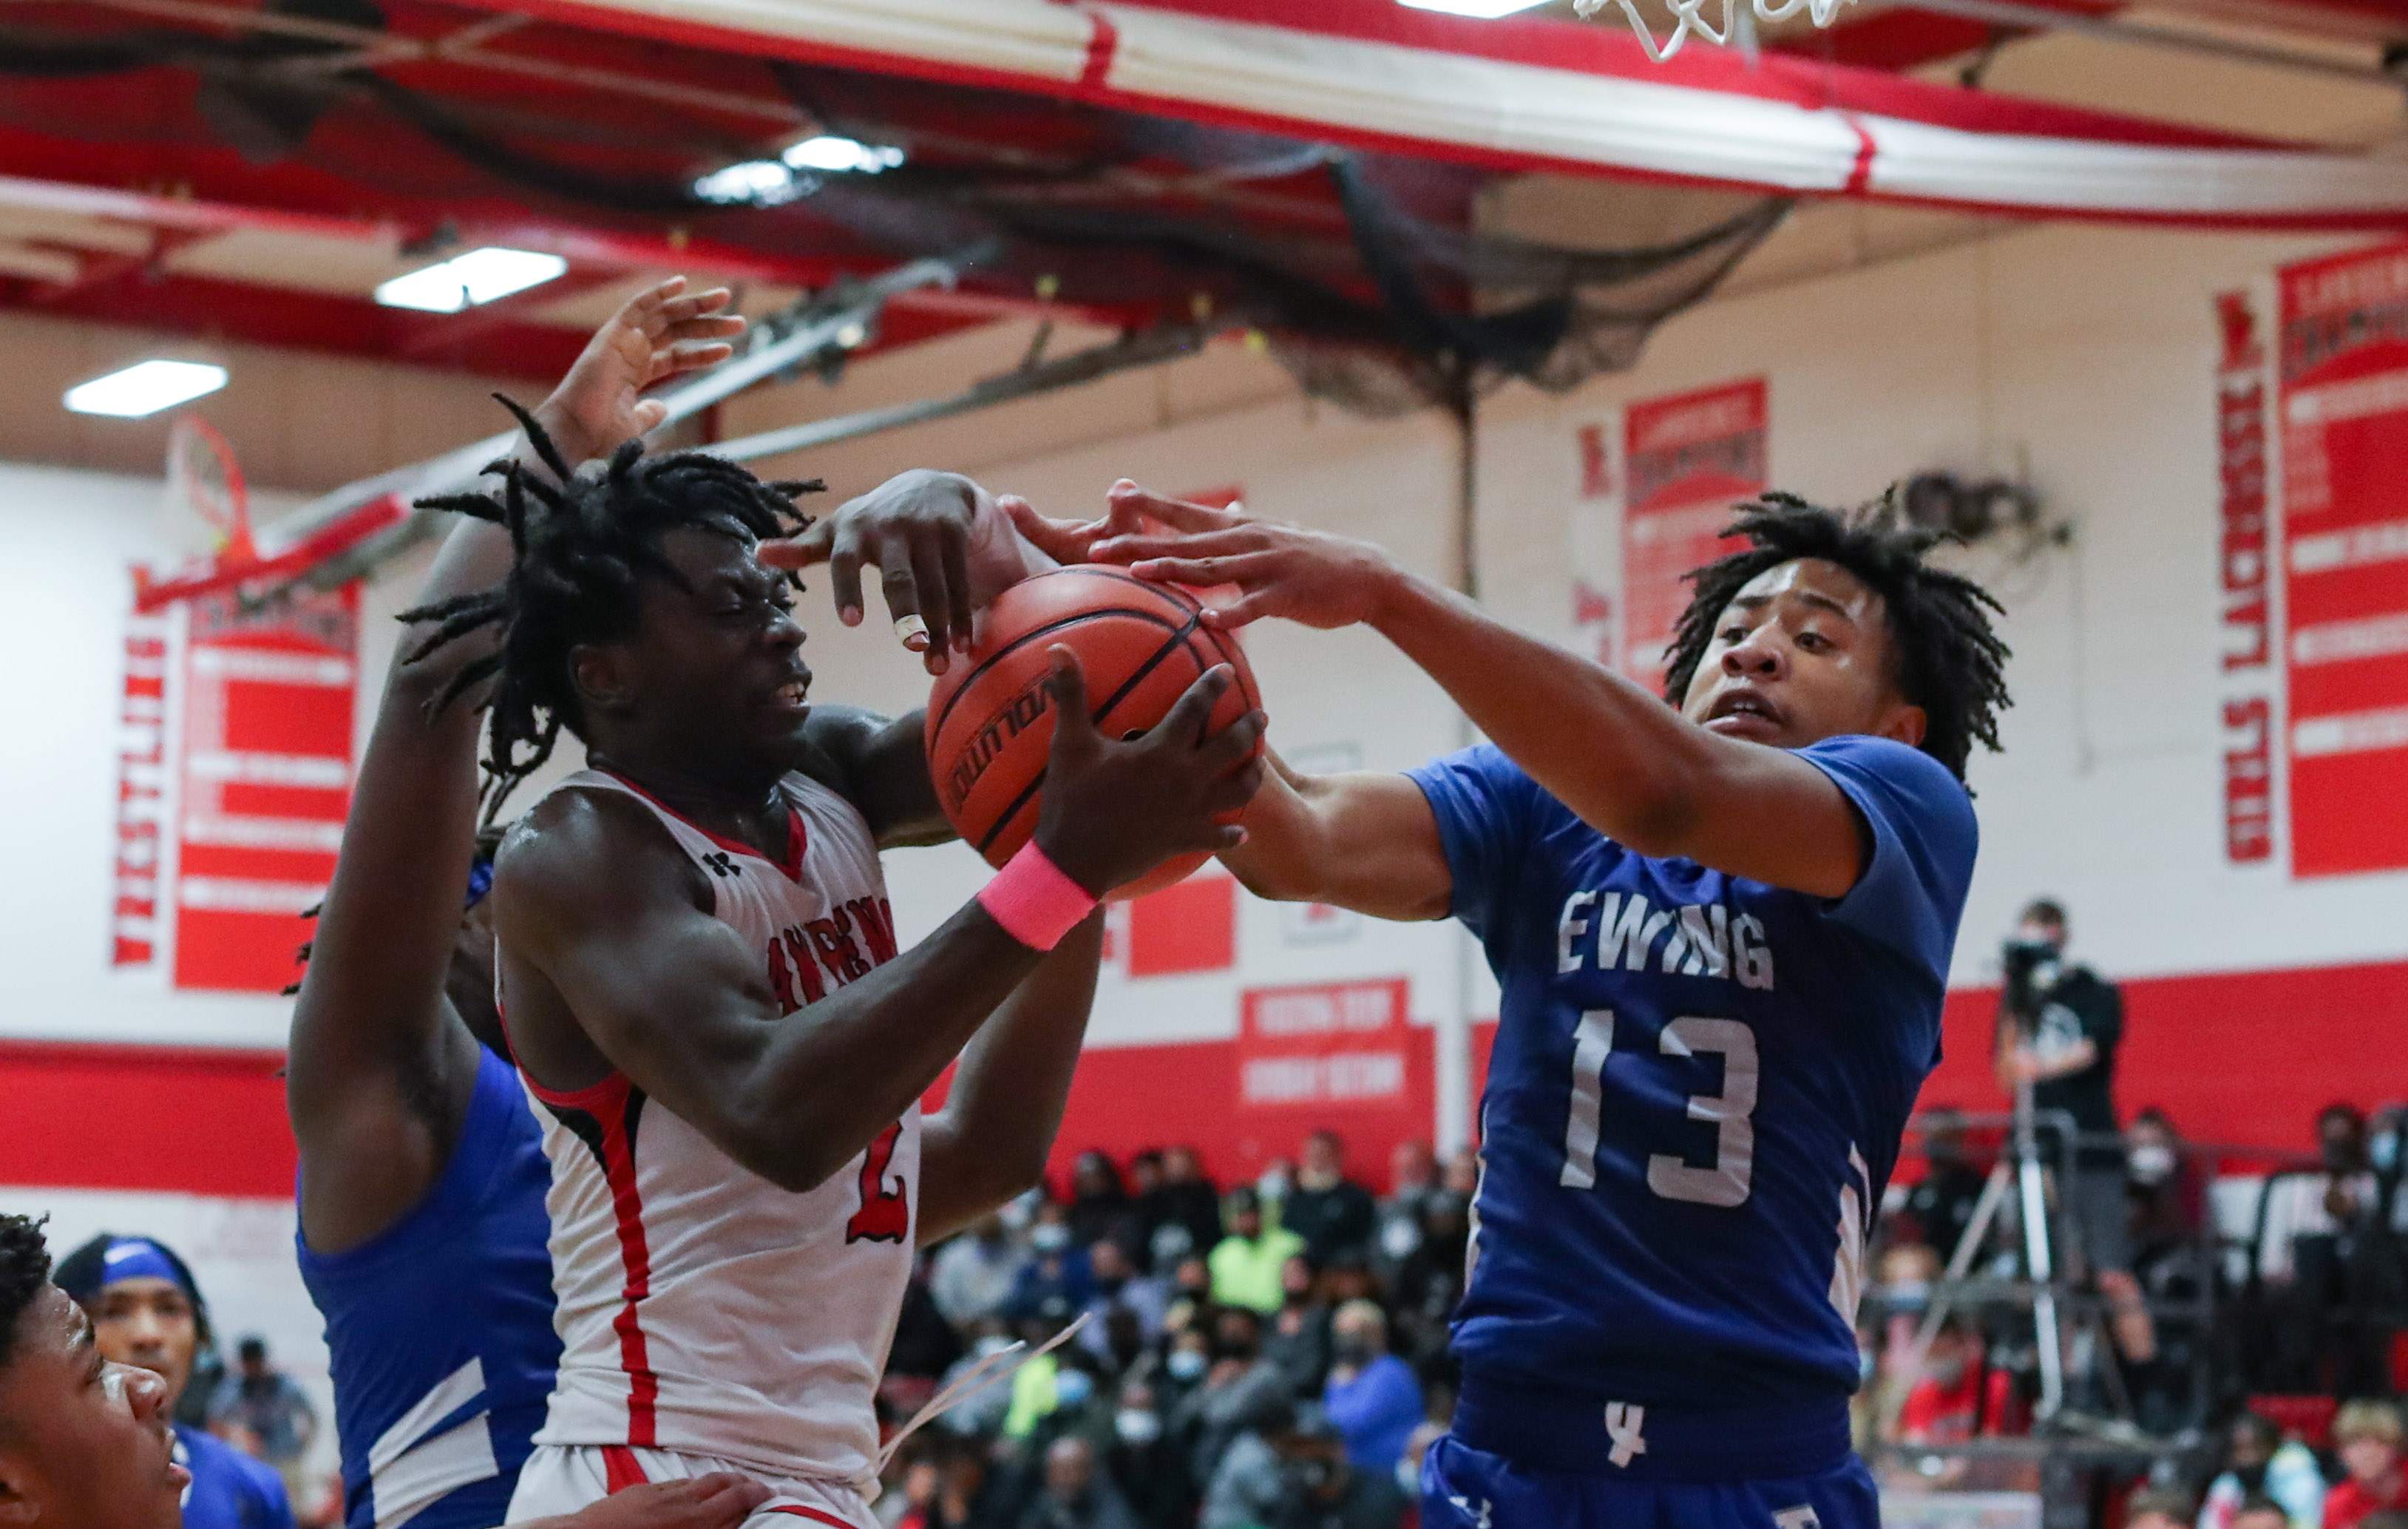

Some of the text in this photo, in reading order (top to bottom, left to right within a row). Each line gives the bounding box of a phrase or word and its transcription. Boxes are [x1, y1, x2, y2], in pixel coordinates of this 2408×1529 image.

[2222, 698, 2272, 863] GIRLS
[1557, 889, 1774, 991] EWING
[1559, 1008, 1760, 1208] 13
